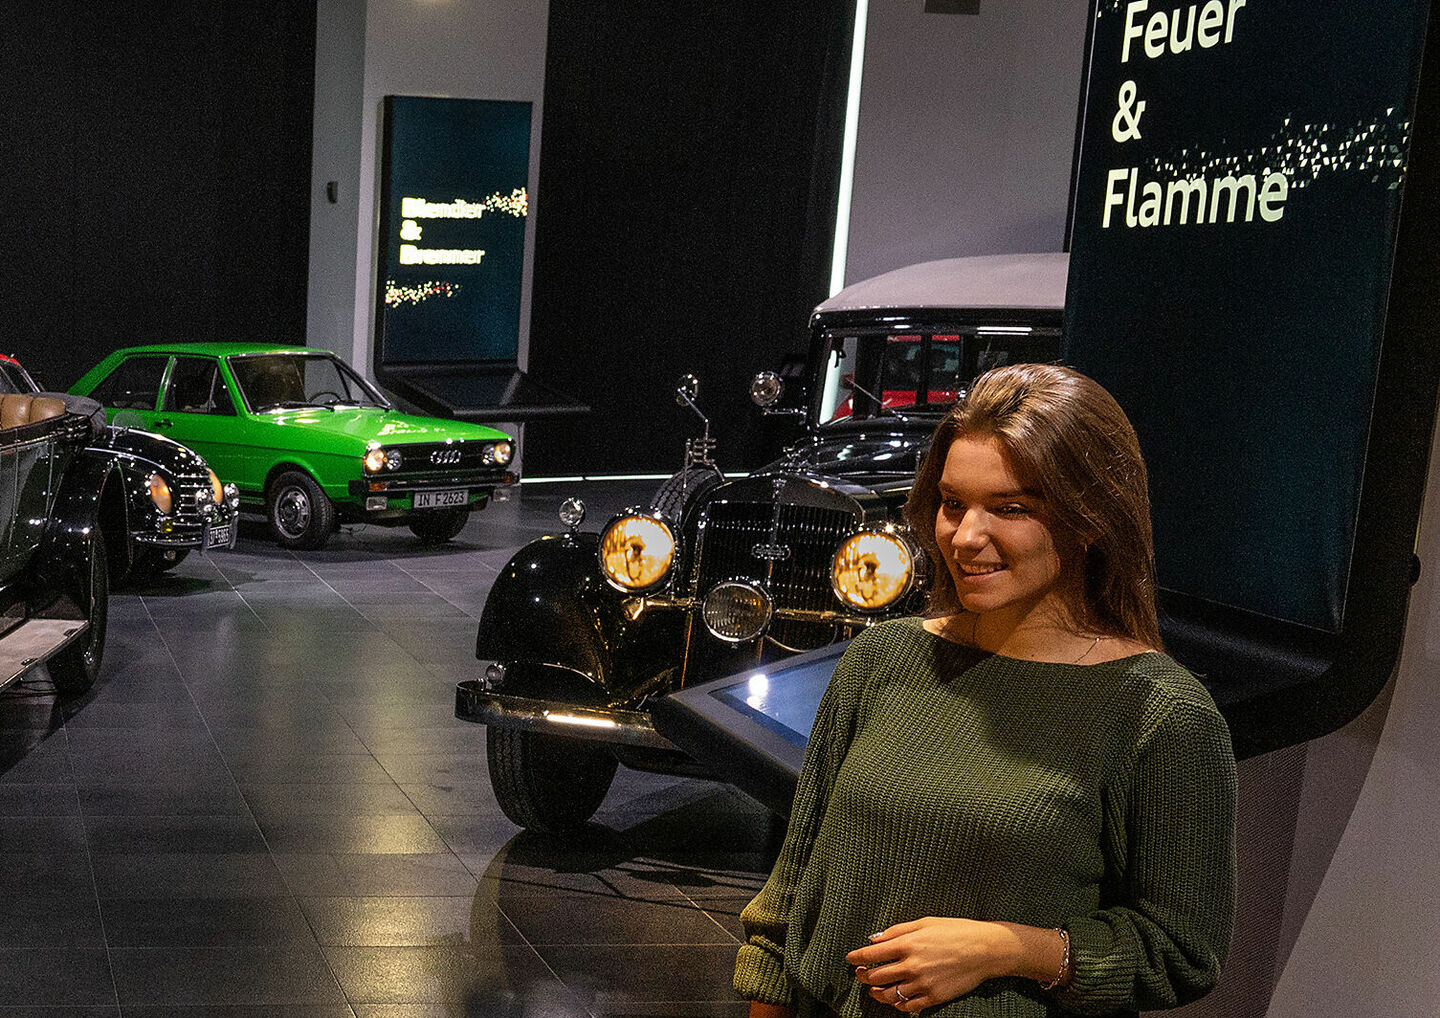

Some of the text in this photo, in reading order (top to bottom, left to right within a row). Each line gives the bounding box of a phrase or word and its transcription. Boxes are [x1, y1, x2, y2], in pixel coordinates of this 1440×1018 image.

[1121, 0, 1246, 63] Feuer
[1111, 80, 1146, 143] &
[1102, 168, 1289, 229] Flamme
[418, 491, 465, 506] IN F 2623
